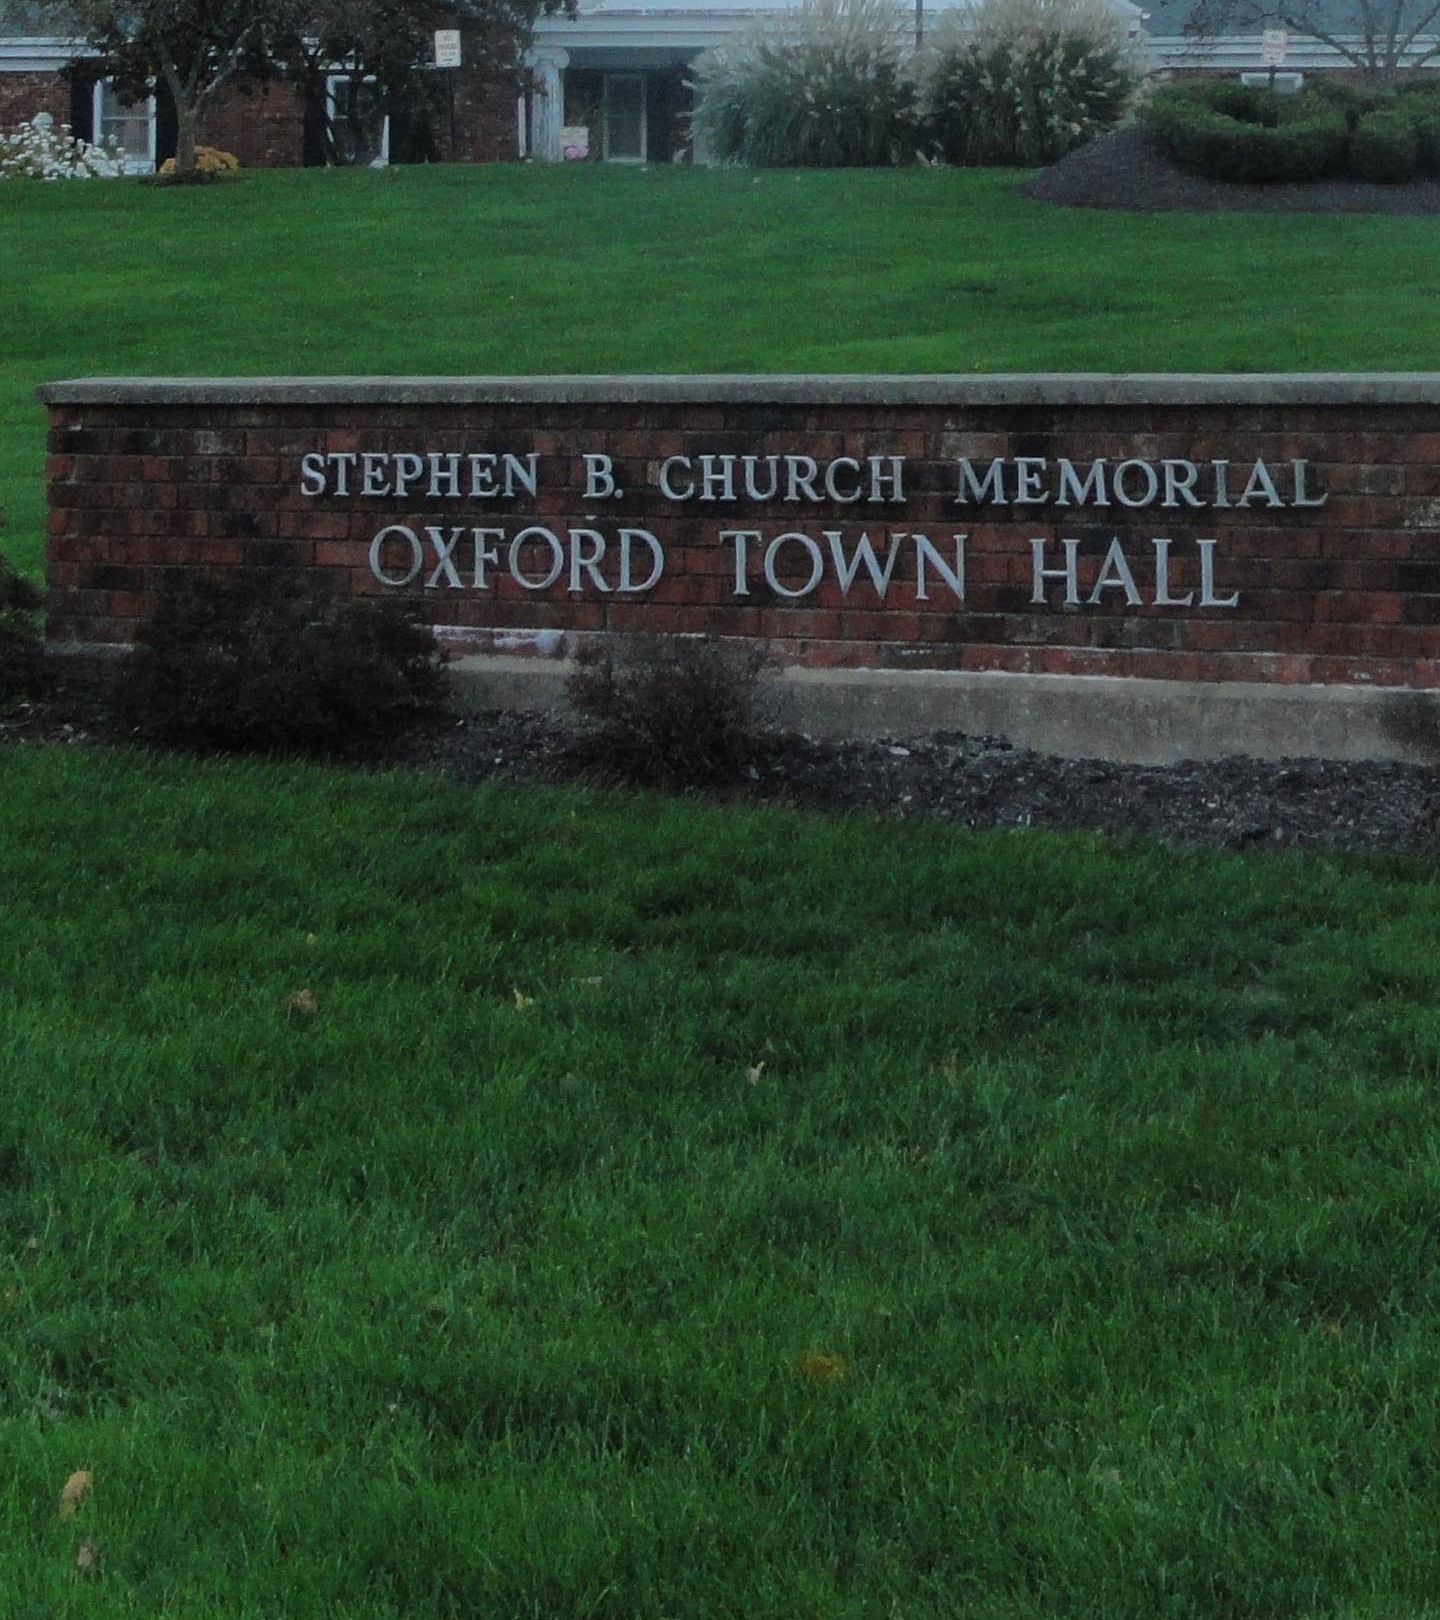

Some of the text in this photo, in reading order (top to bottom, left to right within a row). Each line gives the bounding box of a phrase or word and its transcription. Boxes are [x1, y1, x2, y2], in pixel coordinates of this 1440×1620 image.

[300, 452, 1329, 508] STEPHEN B. CHURCH MEMORIAL
[368, 524, 1240, 608] OXFORD TOWN HALL
